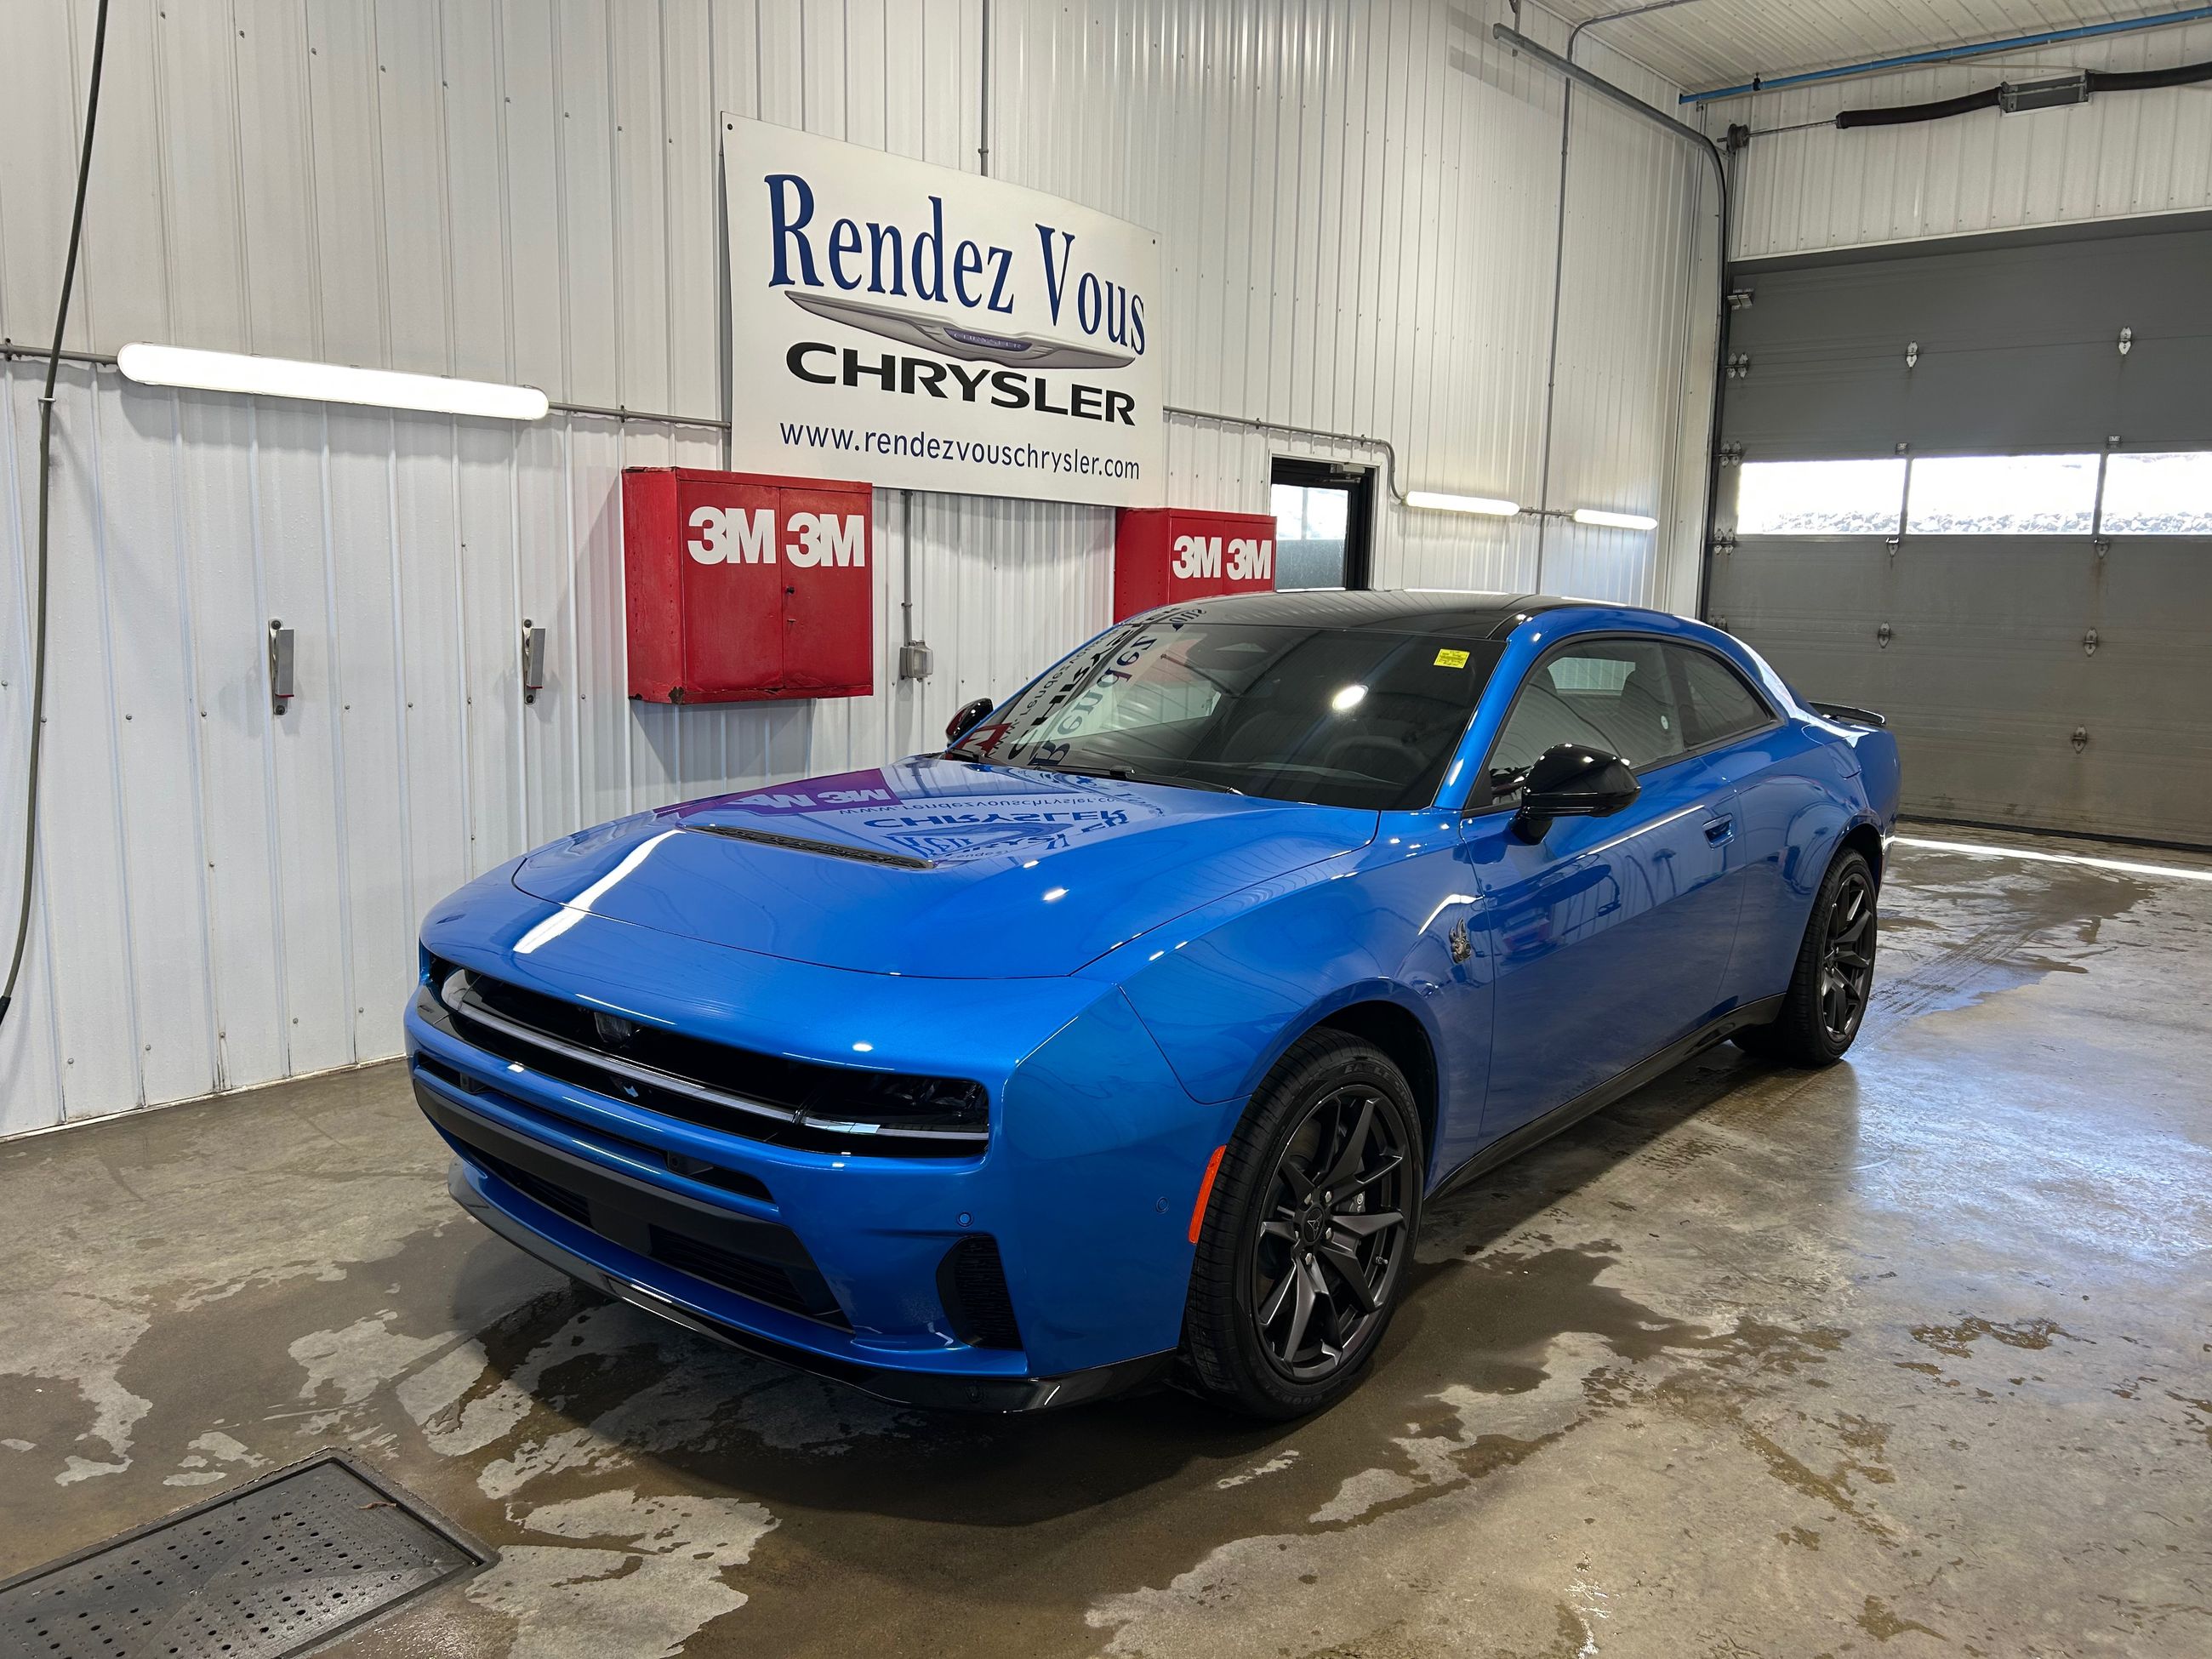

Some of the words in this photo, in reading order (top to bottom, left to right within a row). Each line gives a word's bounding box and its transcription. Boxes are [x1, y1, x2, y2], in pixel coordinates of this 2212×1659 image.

[764, 174, 1015, 315] Rendez
[1035, 222, 1146, 356] Vous
[785, 342, 1136, 426] CHRYSLER
[779, 422, 1141, 480] www.rendezvouschrysler.com
[687, 506, 777, 565] 3M
[785, 512, 865, 567] 3M
[1172, 535, 1223, 579] 3M
[1226, 538, 1273, 580] 3M
